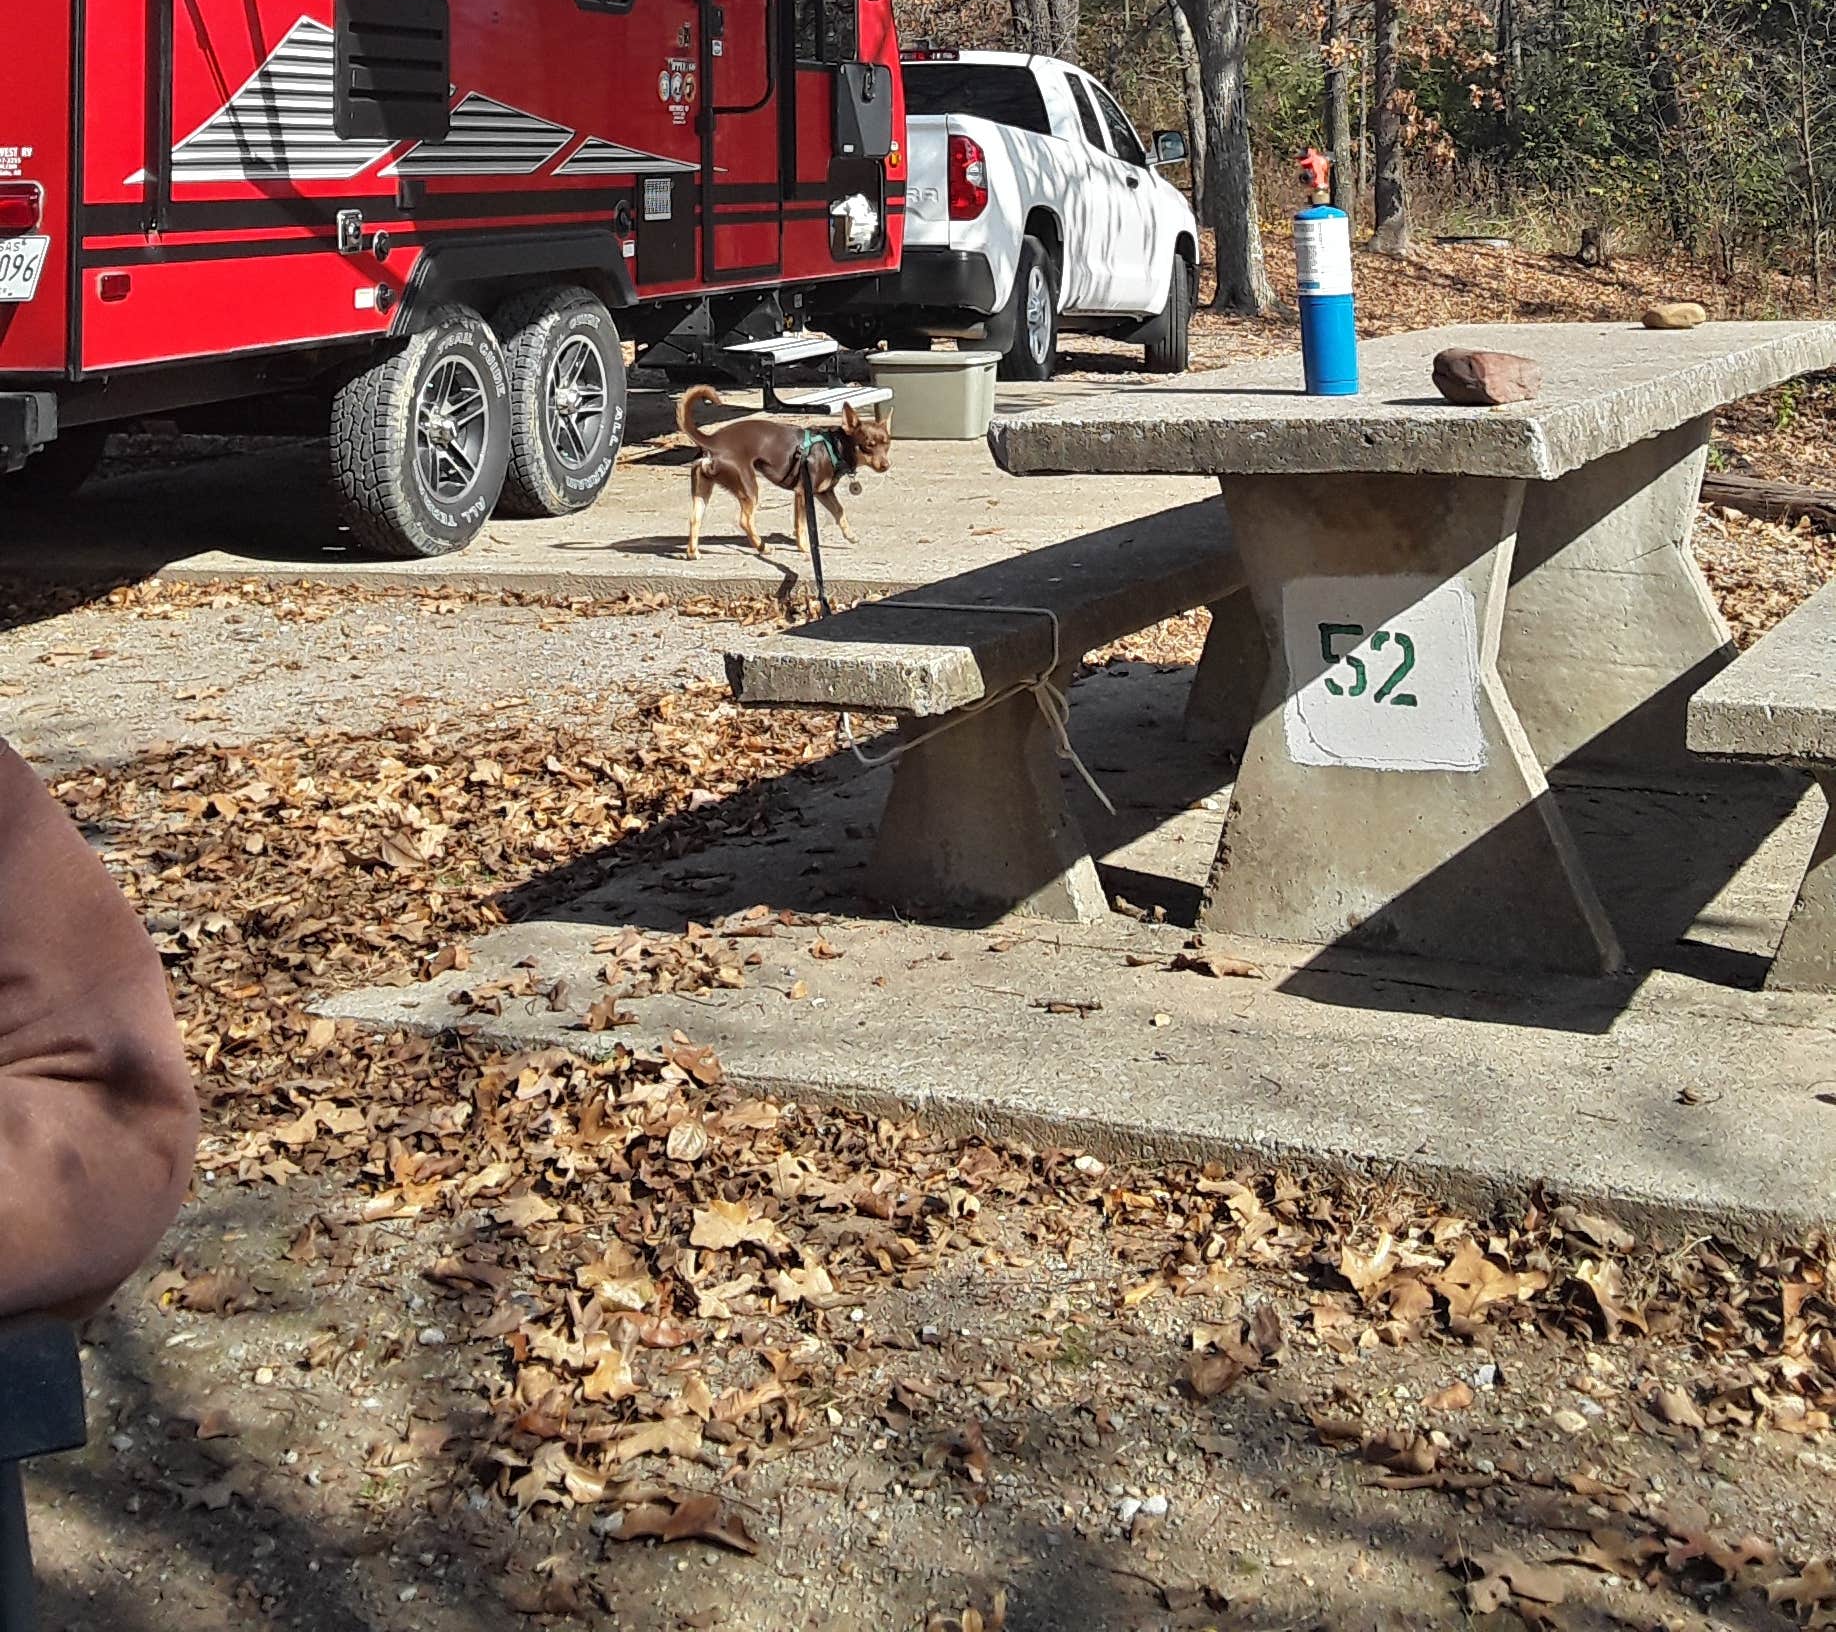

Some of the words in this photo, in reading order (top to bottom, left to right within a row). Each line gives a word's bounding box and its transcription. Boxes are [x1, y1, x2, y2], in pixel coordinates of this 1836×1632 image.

[479, 342, 506, 399] GUIDE
[608, 405, 624, 447] ALL
[461, 495, 486, 524] ALL
[1318, 622, 1418, 708] 52
